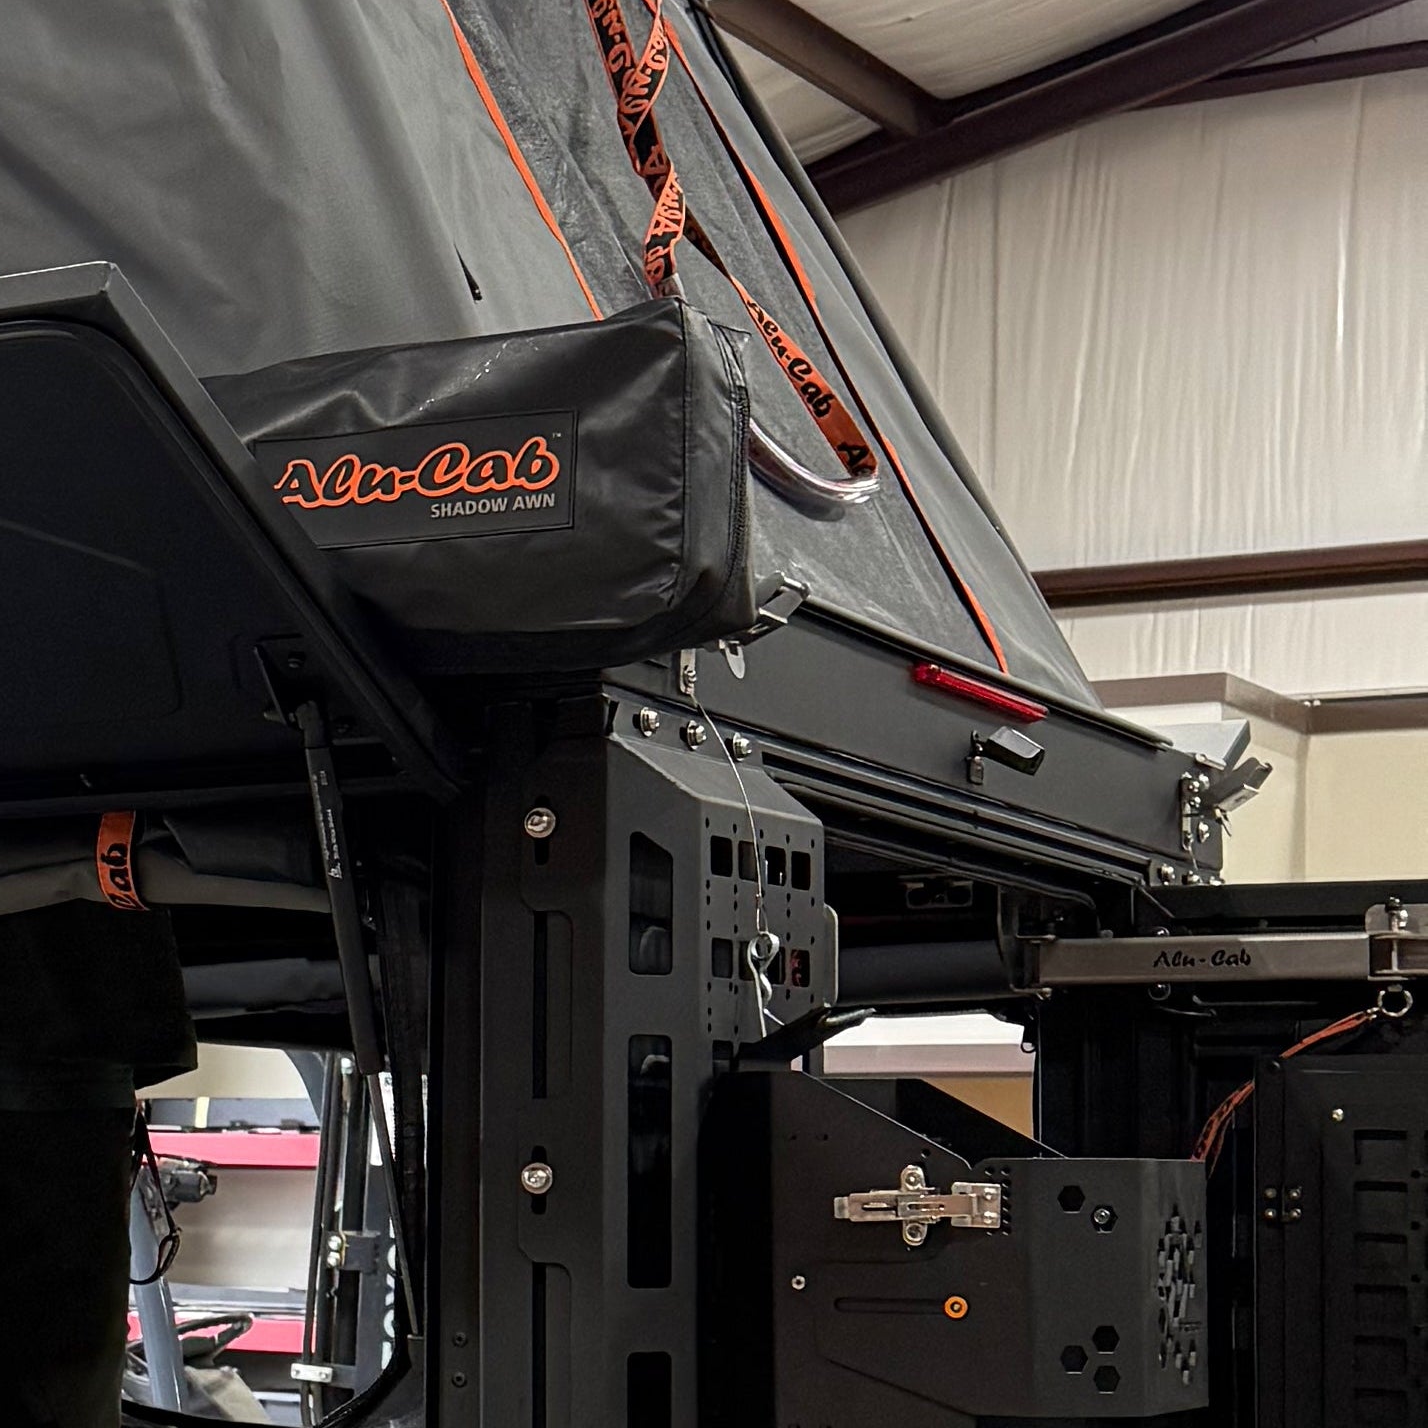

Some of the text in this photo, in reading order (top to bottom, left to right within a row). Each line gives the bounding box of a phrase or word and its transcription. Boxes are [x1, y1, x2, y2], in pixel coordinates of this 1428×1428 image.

[746, 299, 834, 418] Alu-Cab
[274, 436, 560, 508] Alu-Cab
[430, 493, 556, 518] SHADOW AWN
[1153, 948, 1251, 968] Alu-Cab
